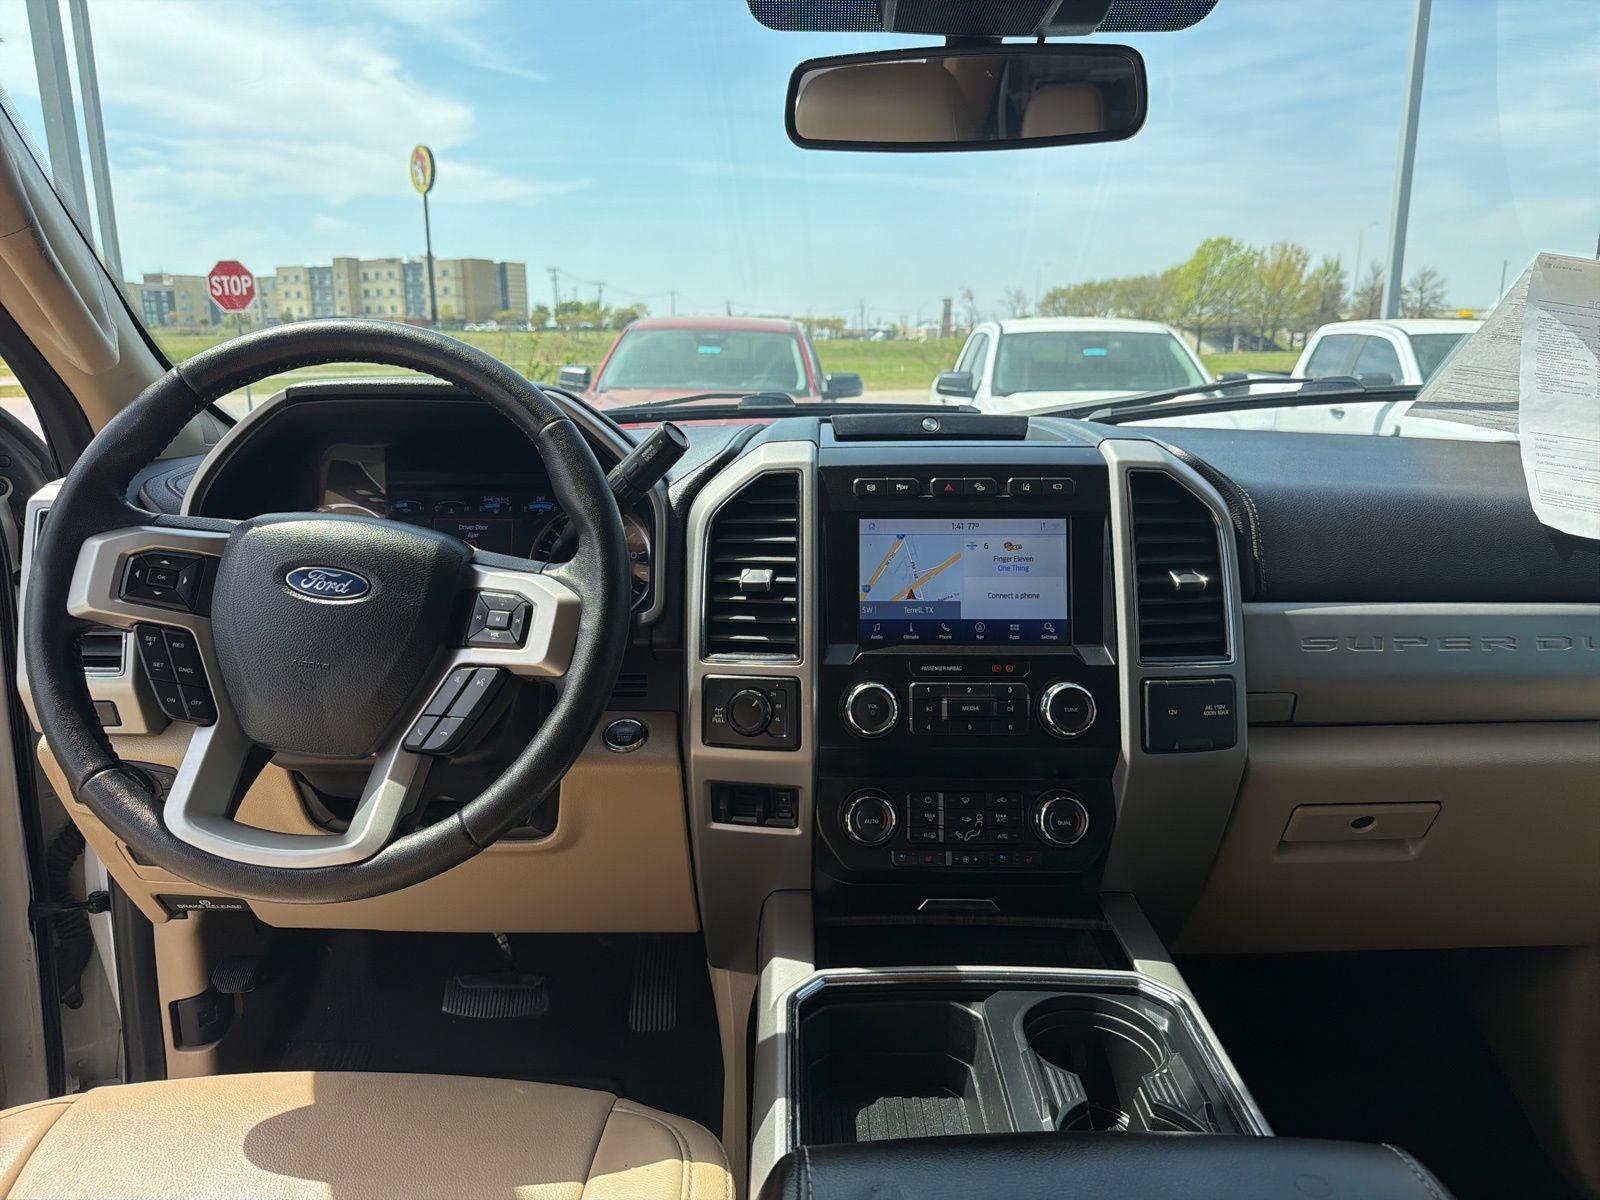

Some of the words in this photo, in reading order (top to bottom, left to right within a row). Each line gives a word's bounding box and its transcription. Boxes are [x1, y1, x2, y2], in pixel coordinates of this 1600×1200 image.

[211, 275, 252, 296] STOP
[951, 522, 964, 530] 1:41
[983, 542, 989, 550] 6
[993, 555, 1013, 564] Finger
[1012, 564, 1030, 573] Thing
[301, 569, 353, 593] Ford
[987, 592, 1013, 600] Connect
[1020, 592, 1041, 602] phone
[1301, 636, 1517, 652] SUPER
